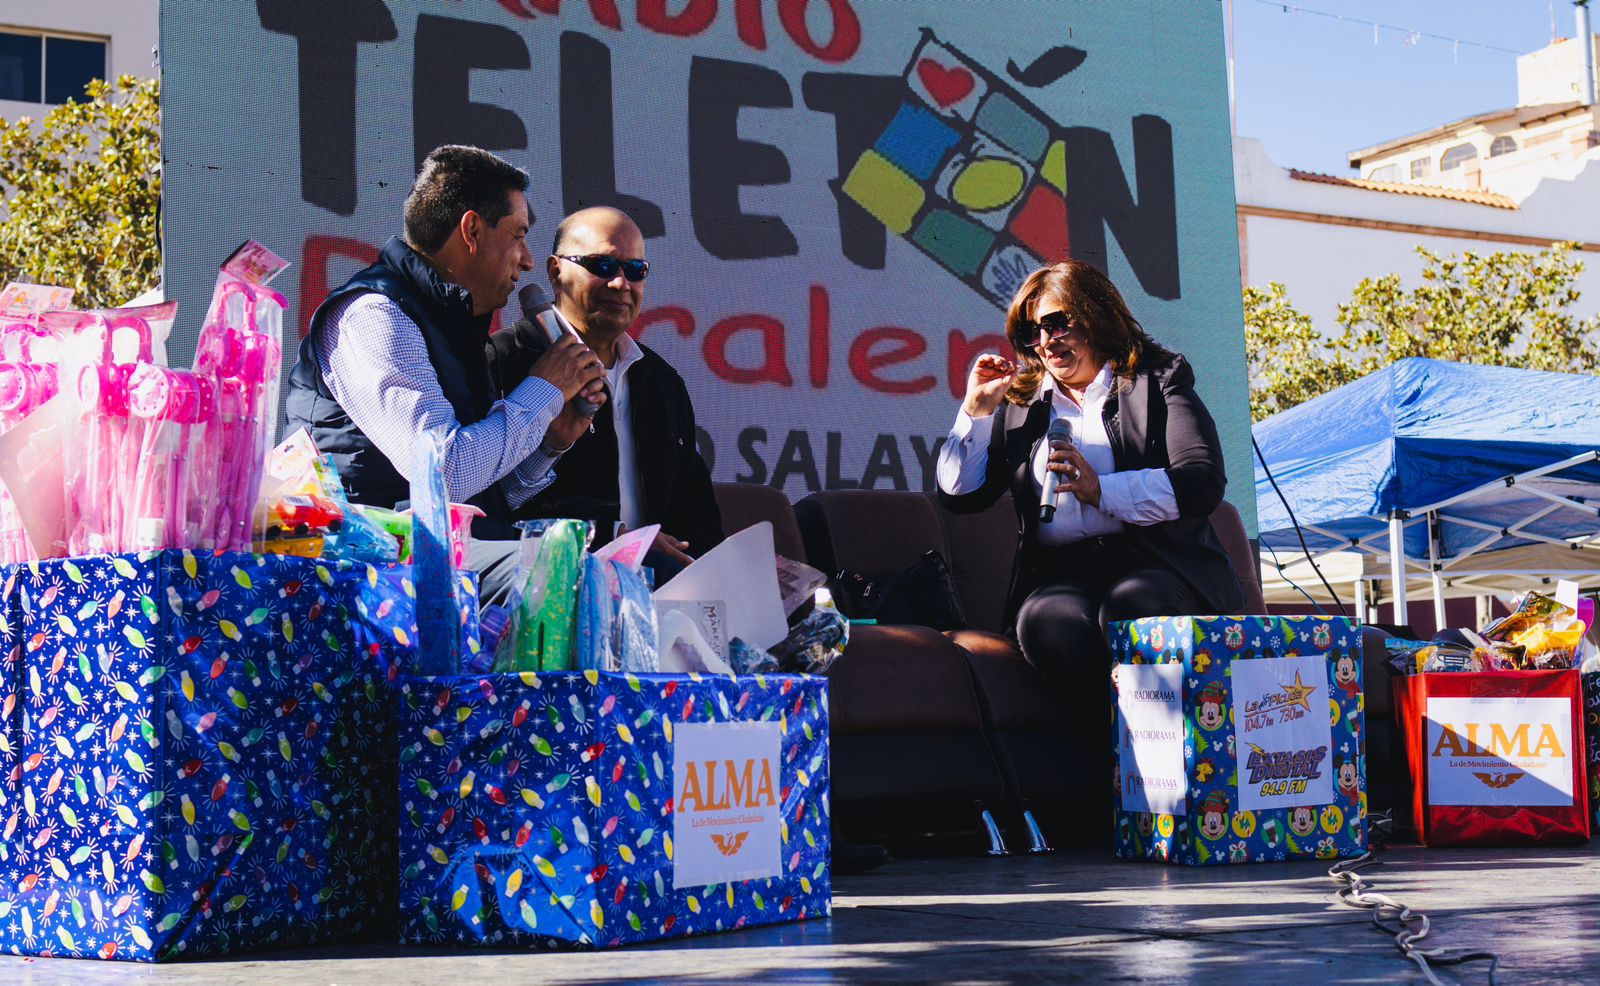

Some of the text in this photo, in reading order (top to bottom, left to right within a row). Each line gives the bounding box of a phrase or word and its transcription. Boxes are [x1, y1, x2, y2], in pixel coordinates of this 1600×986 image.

[736, 426, 948, 492] SALAY
[1134, 690, 1175, 701] RADIORAMA
[1134, 730, 1176, 741] RADIORAMA
[1432, 723, 1566, 758] ALMA
[1246, 746, 1328, 770] EXTASIS
[1136, 776, 1177, 789] RADIORAMA
[1248, 759, 1322, 784] DIGITAL
[677, 758, 776, 813] ALMA
[1260, 779, 1308, 797] 94.9 FM
